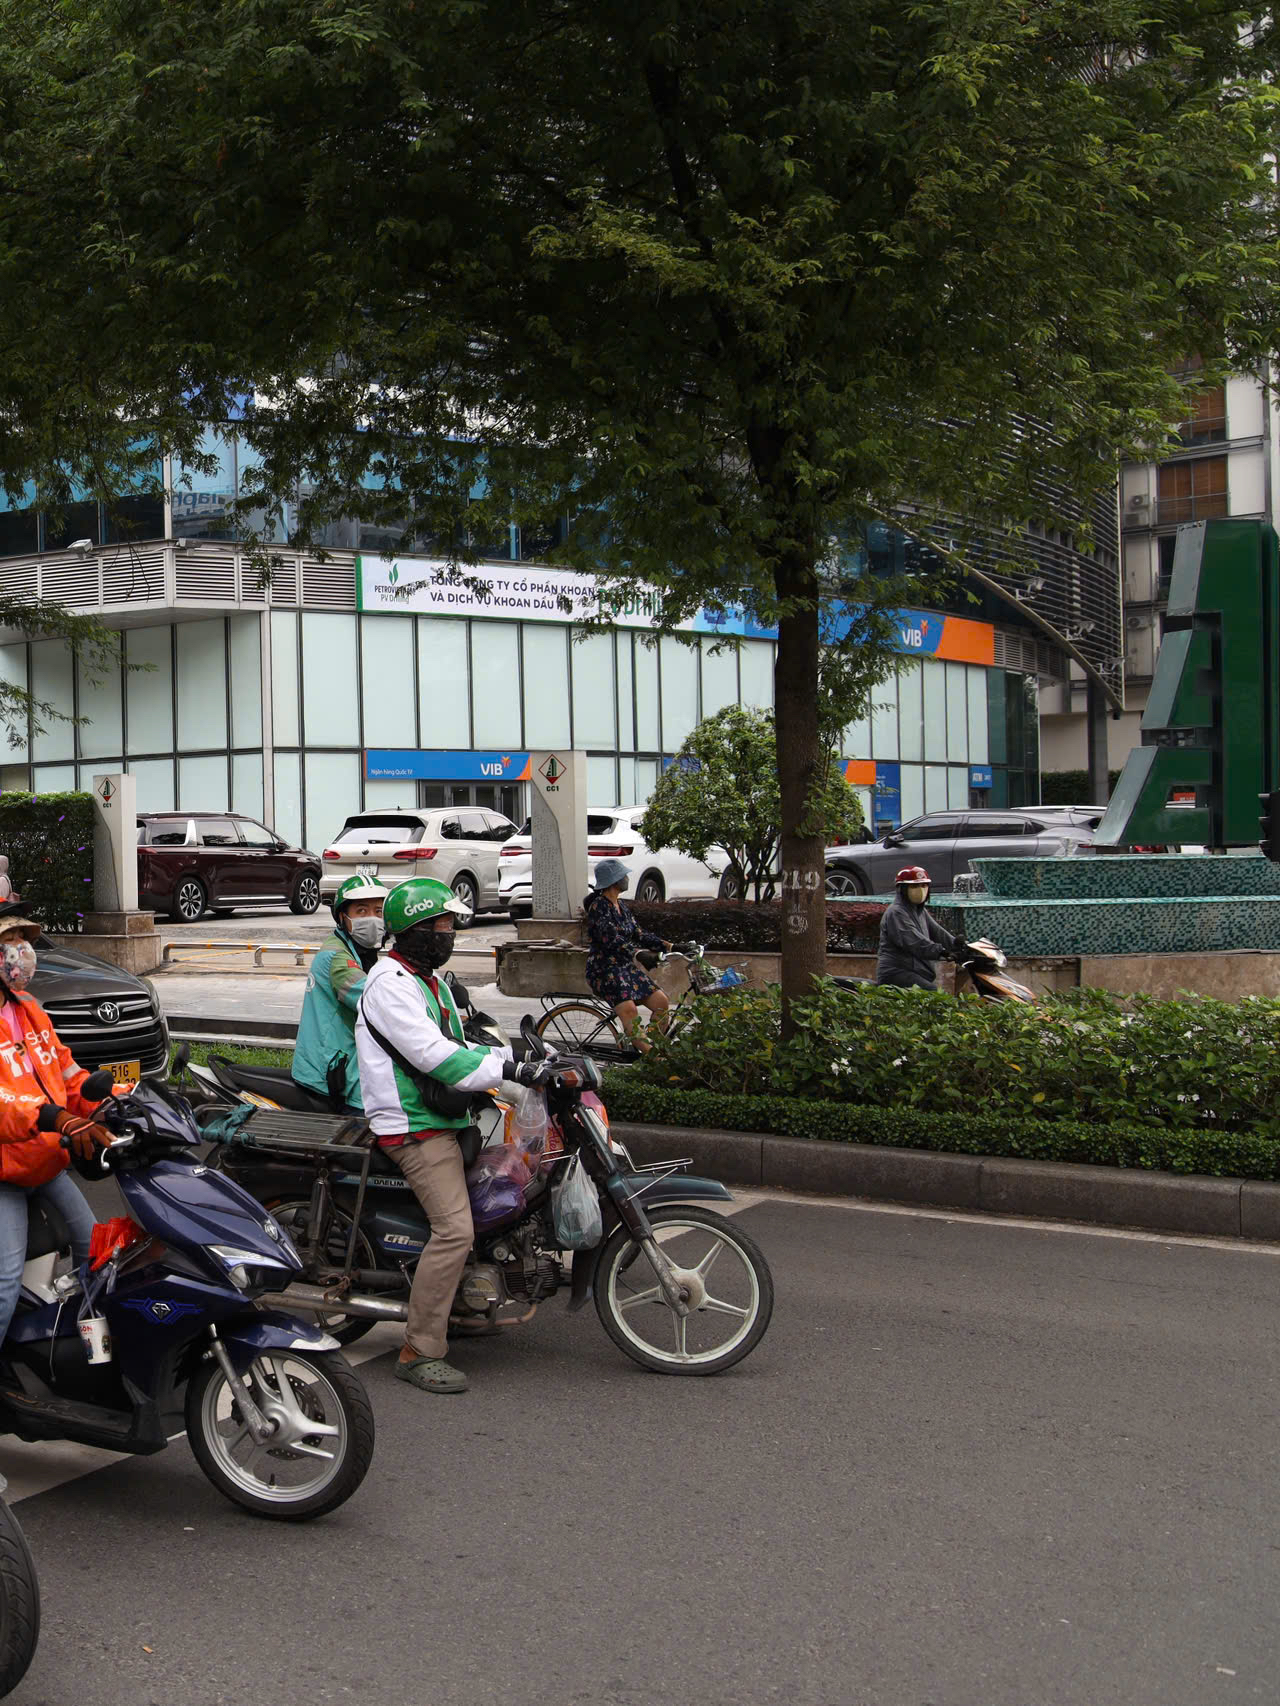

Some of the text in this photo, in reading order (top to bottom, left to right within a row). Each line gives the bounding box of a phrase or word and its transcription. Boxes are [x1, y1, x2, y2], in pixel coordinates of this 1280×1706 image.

[497, 580, 510, 590] TY
[513, 577, 528, 592] CỔ
[560, 585, 595, 596] KHOAN
[430, 589, 445, 602] VÀ
[448, 593, 473, 605] DỊCH
[494, 596, 531, 608] KHOAN
[902, 628, 922, 647] VIB
[480, 763, 503, 776] VIB
[404, 898, 435, 917] Grab
[111, 1064, 129, 1079] 51G
[373, 1179, 405, 1188] DAELIM
